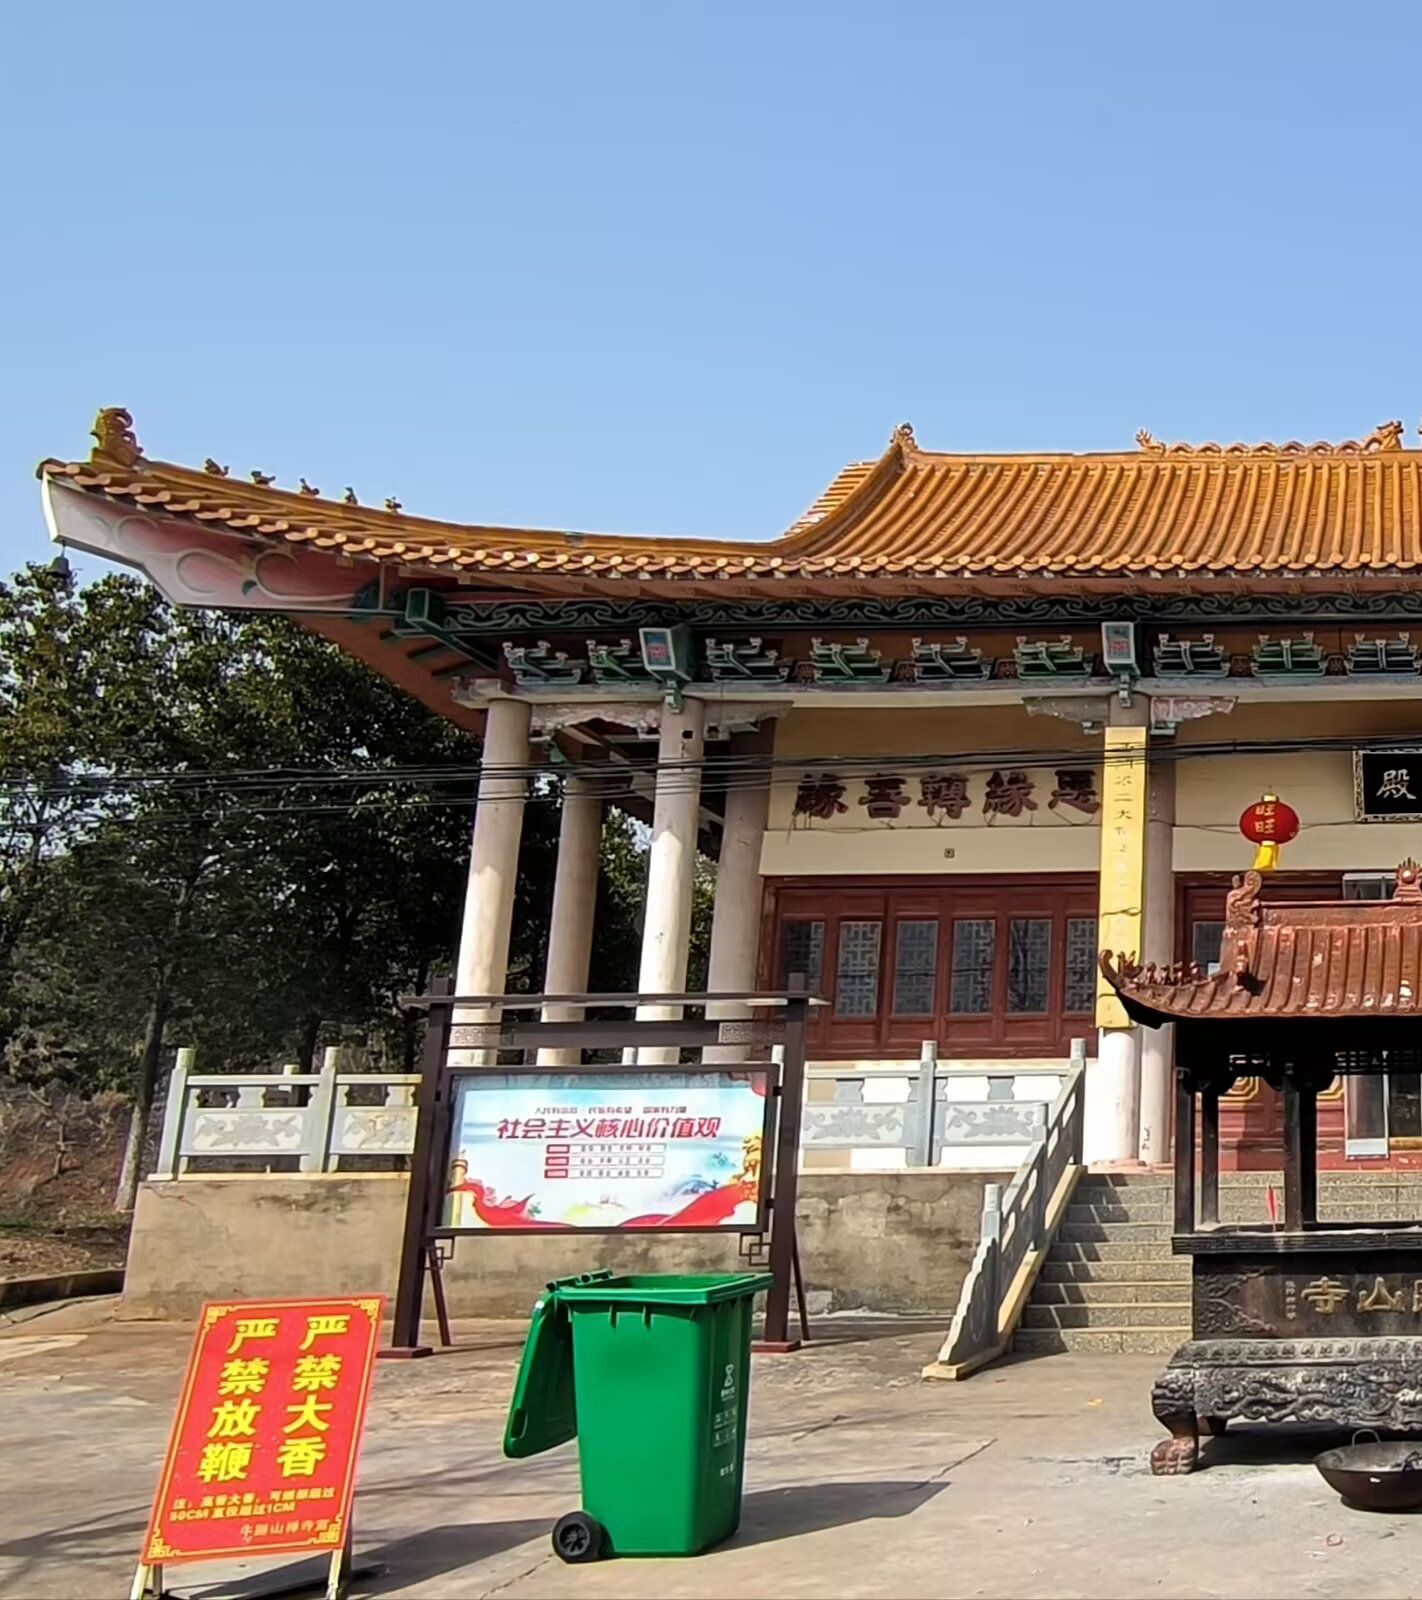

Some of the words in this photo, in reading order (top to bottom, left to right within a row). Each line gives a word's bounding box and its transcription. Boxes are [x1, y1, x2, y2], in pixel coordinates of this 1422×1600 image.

[496, 1116, 722, 1139] 社会主义核心价值观
[196, 1318, 281, 1484] 严禁放鞭
[277, 1314, 351, 1477] 严禁大香
